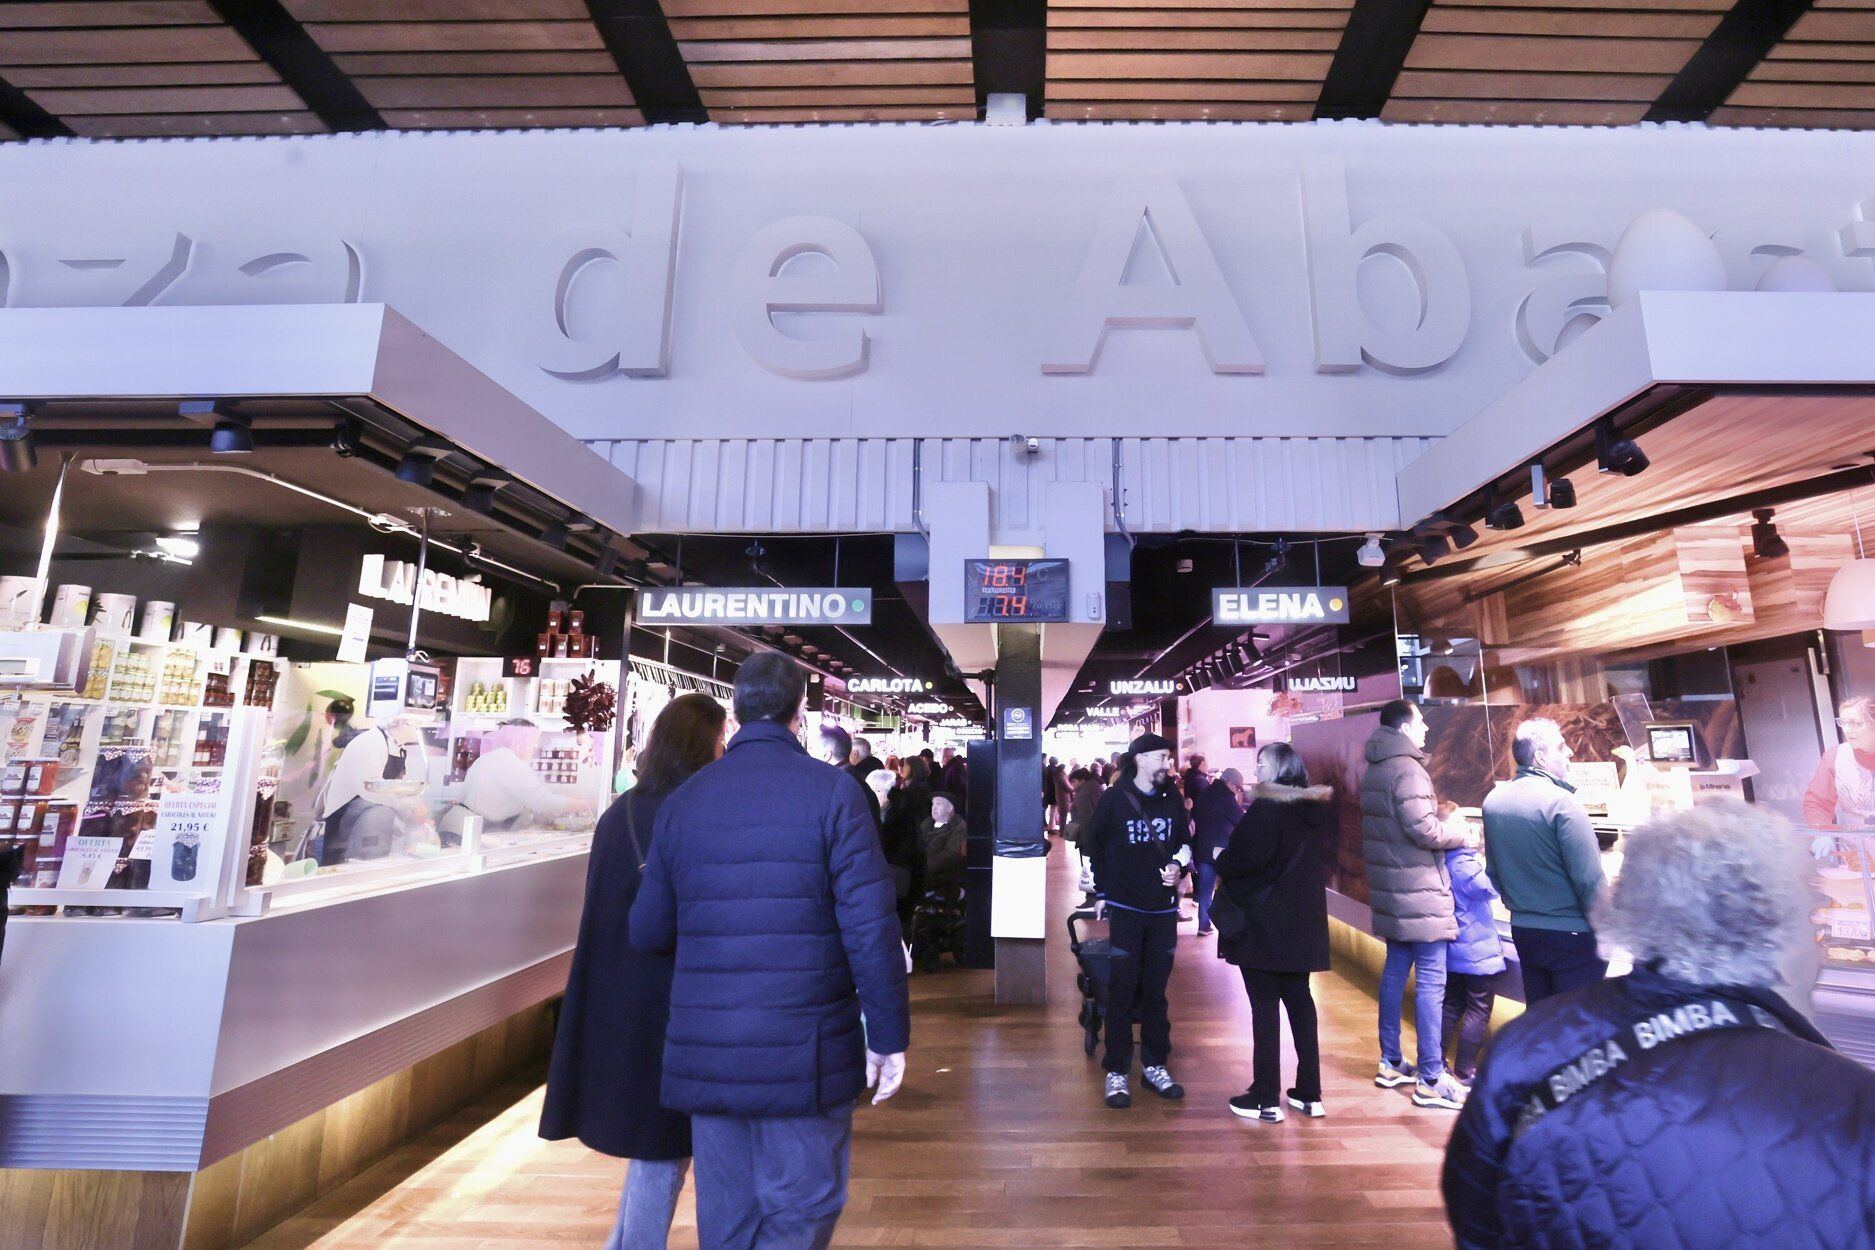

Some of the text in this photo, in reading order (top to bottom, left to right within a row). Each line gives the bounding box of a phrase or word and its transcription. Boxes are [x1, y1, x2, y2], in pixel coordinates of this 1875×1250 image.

[532, 158, 884, 381] de
[642, 592, 846, 618] LAURENTINO
[1219, 593, 1325, 619] ELENA
[848, 679, 923, 692] CARLOTA
[1110, 680, 1174, 694] UNZALU
[1086, 707, 1119, 716] VALLE
[164, 801, 187, 809] OFERTA
[170, 823, 209, 832] 21,95 €
[1549, 1040, 1628, 1102] BIMBA
[1633, 1001, 1740, 1049] BIMBA
